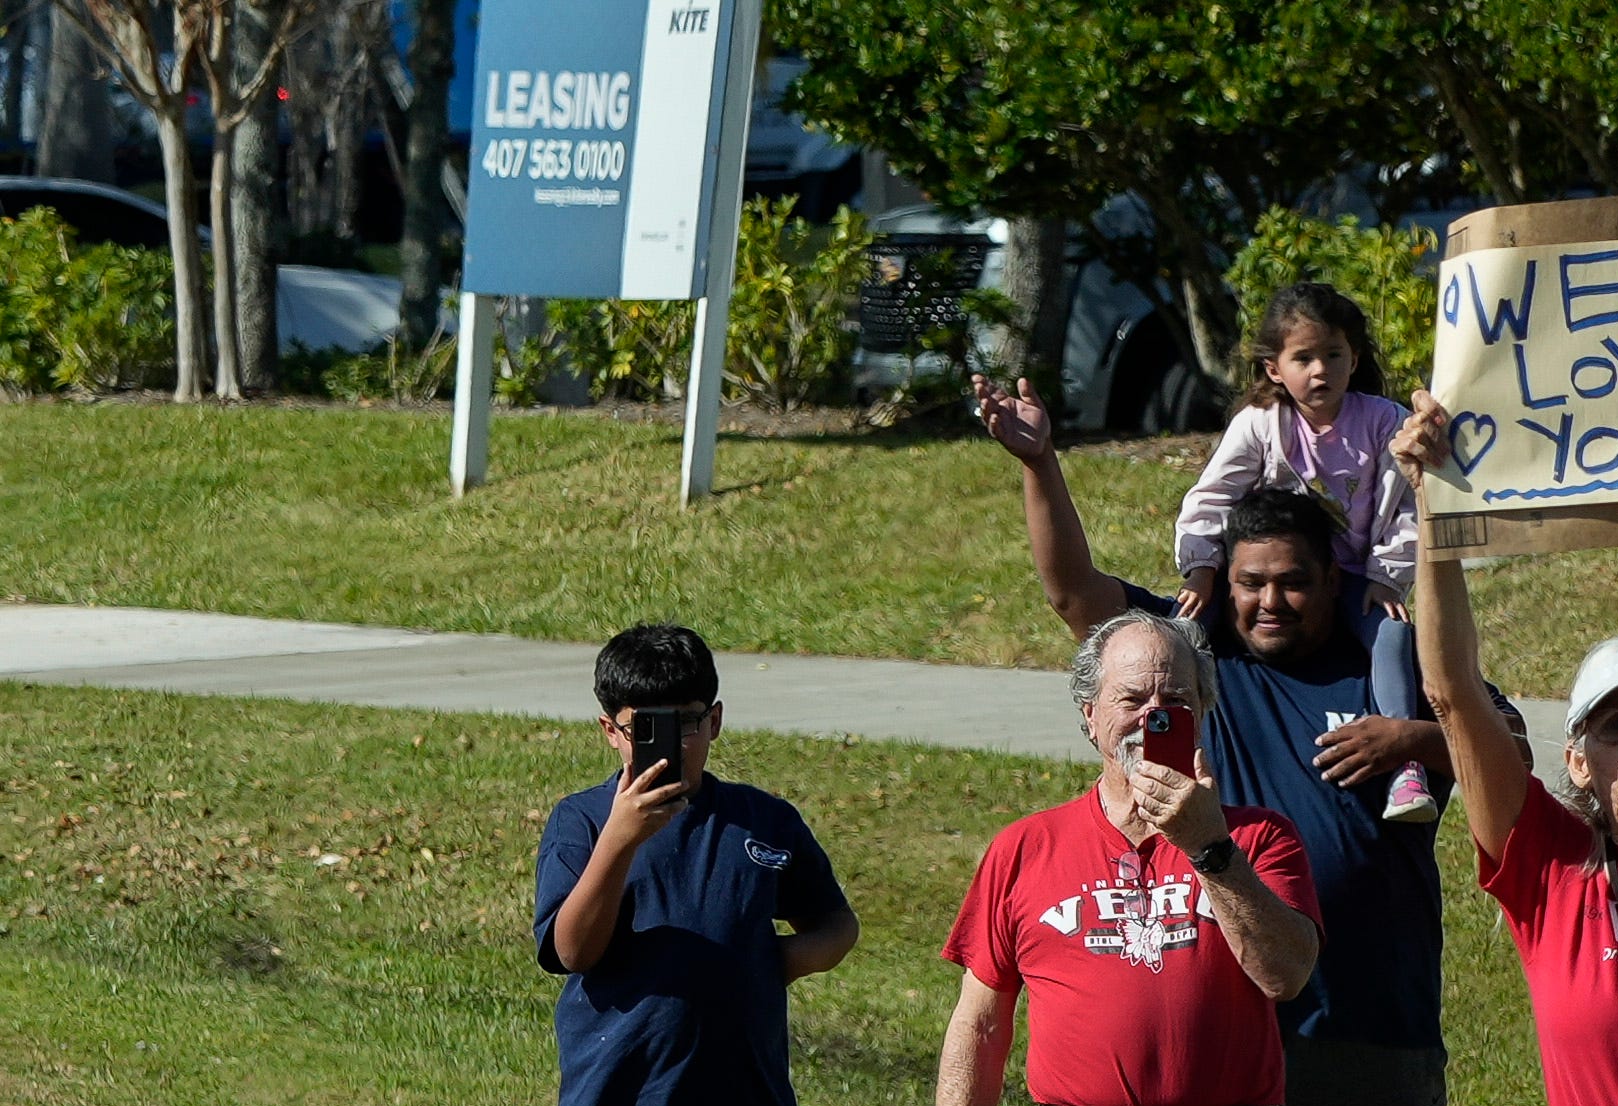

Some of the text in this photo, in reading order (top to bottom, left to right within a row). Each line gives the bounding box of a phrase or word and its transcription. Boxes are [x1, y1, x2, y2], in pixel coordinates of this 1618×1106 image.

[668, 9, 709, 34] KITE
[485, 70, 630, 131] LEASING
[482, 138, 625, 181] 407 563 0100
